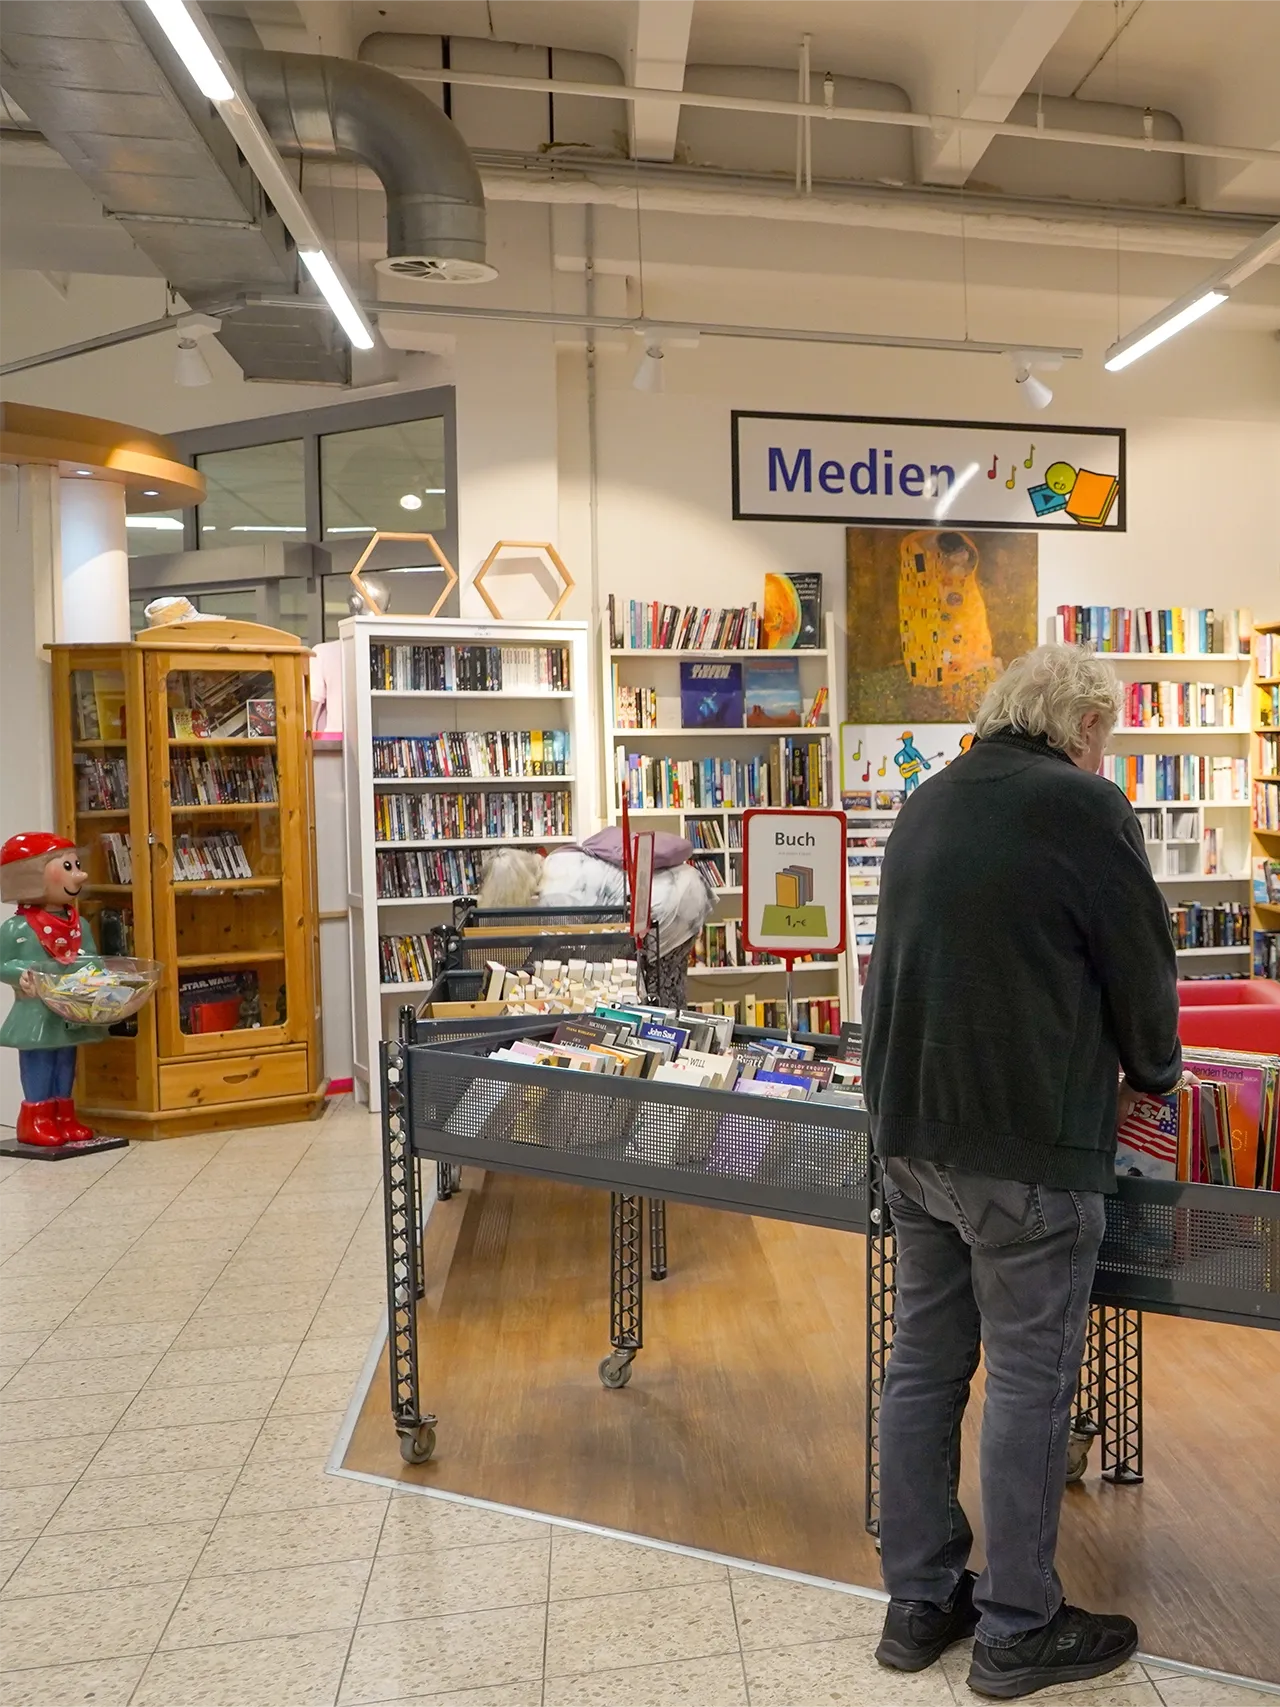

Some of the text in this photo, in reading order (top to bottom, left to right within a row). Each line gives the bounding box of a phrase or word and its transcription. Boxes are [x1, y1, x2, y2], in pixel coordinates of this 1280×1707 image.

[768, 447, 956, 497] Medien
[775, 832, 815, 846] Buch
[648, 1028, 676, 1040] John Saul
[806, 1064, 830, 1073] ENQUIST
[1221, 1072, 1243, 1081] Band
